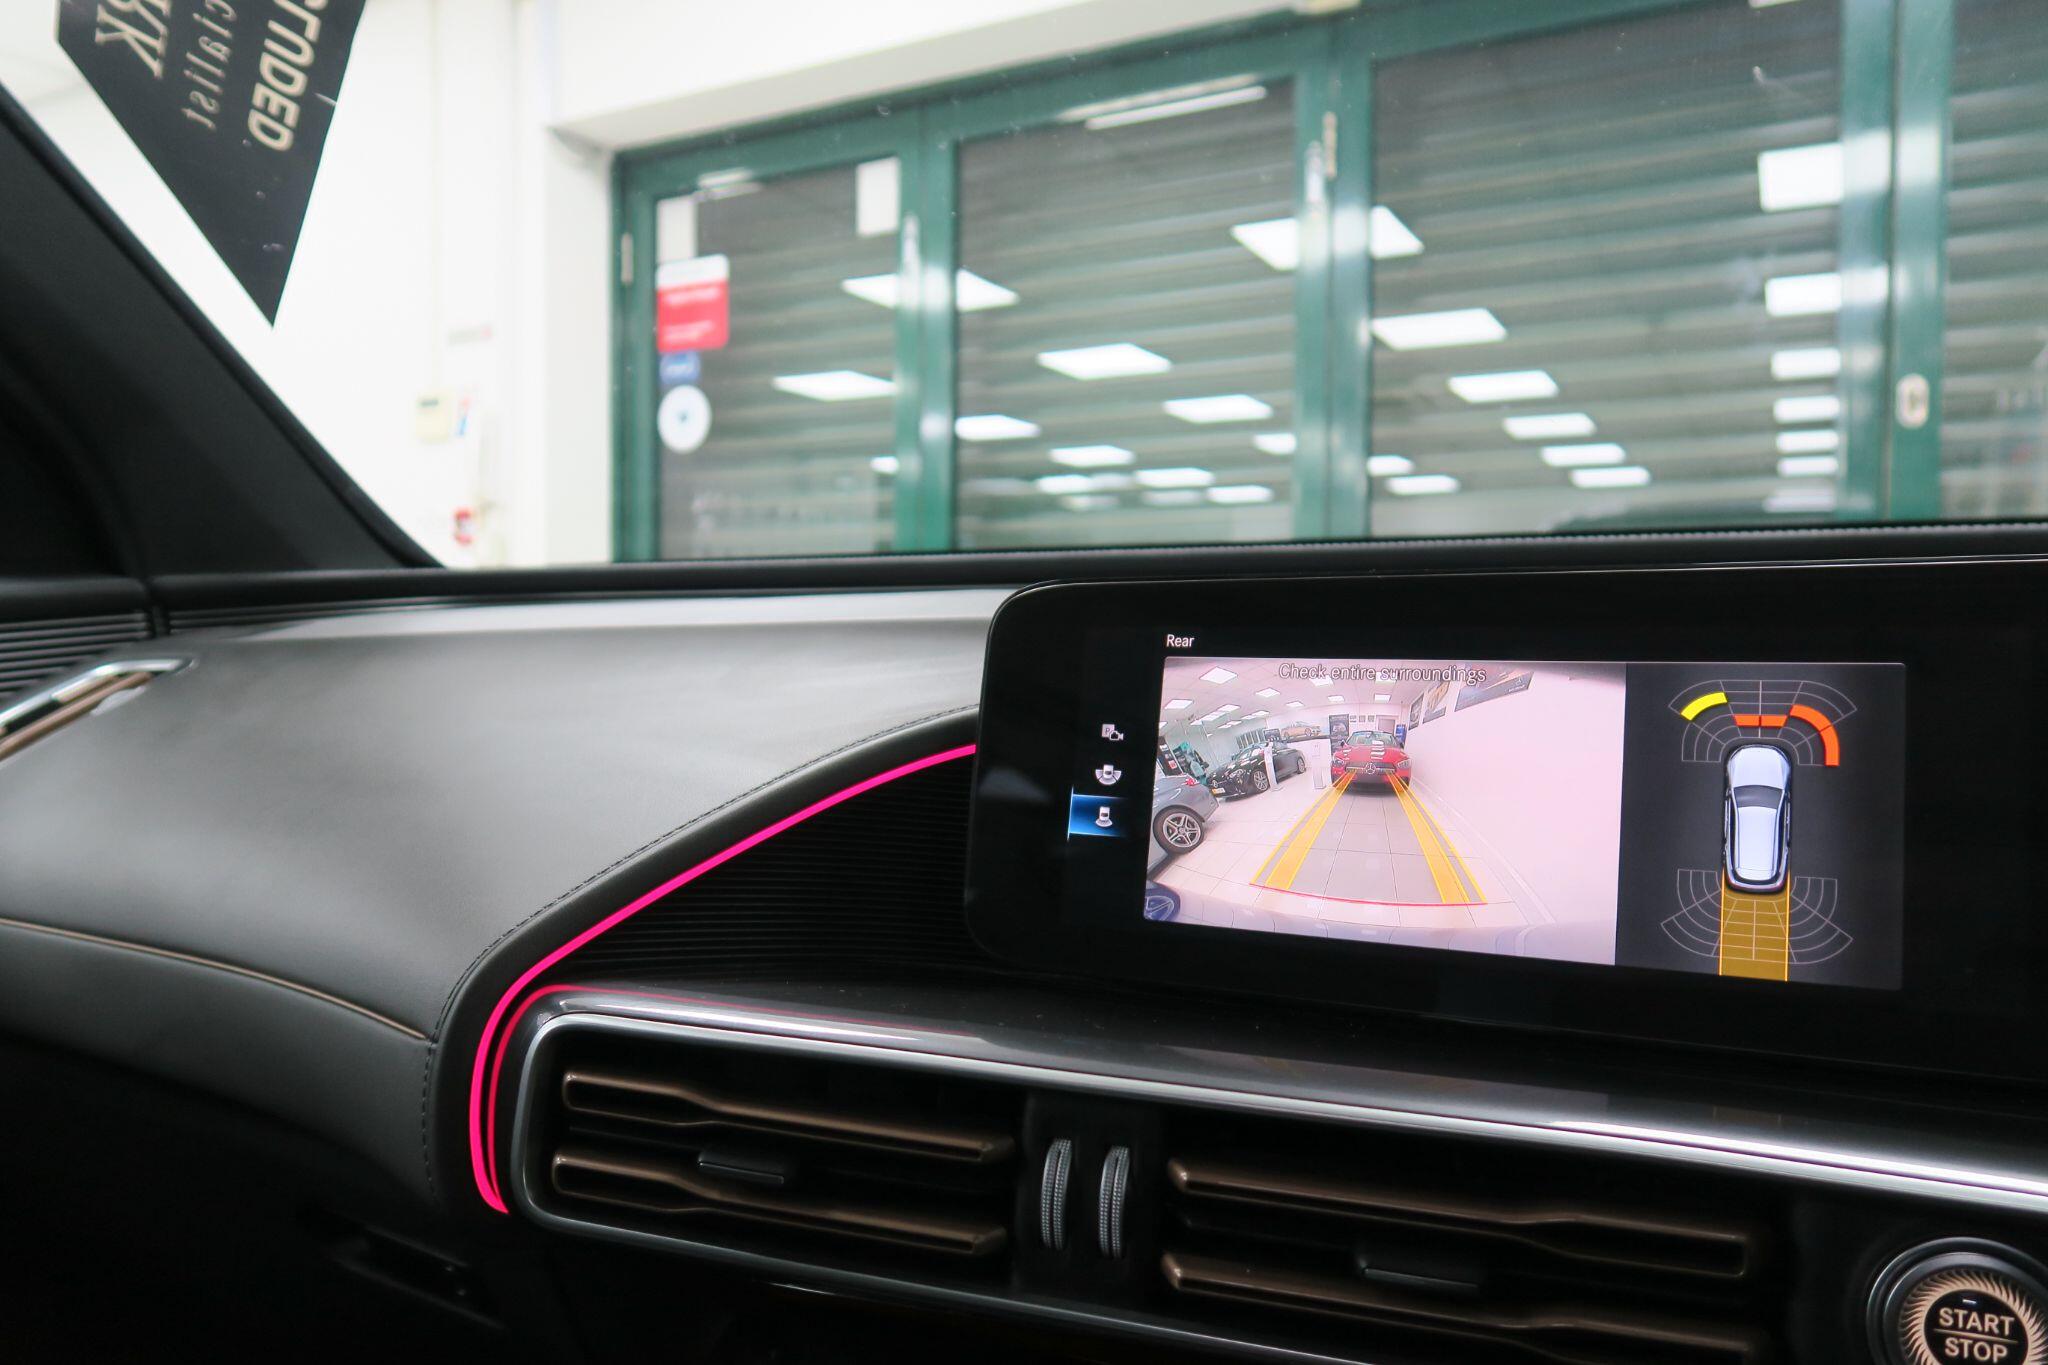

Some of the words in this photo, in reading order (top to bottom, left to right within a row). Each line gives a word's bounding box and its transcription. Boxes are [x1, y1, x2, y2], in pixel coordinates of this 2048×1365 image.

[1166, 633, 1195, 648] Rear
[1279, 663, 1327, 680] Check
[1332, 664, 1375, 680] entire
[1380, 665, 1487, 685] surroundings
[1939, 1307, 2015, 1336] START
[1944, 1337, 2008, 1363] STOP
